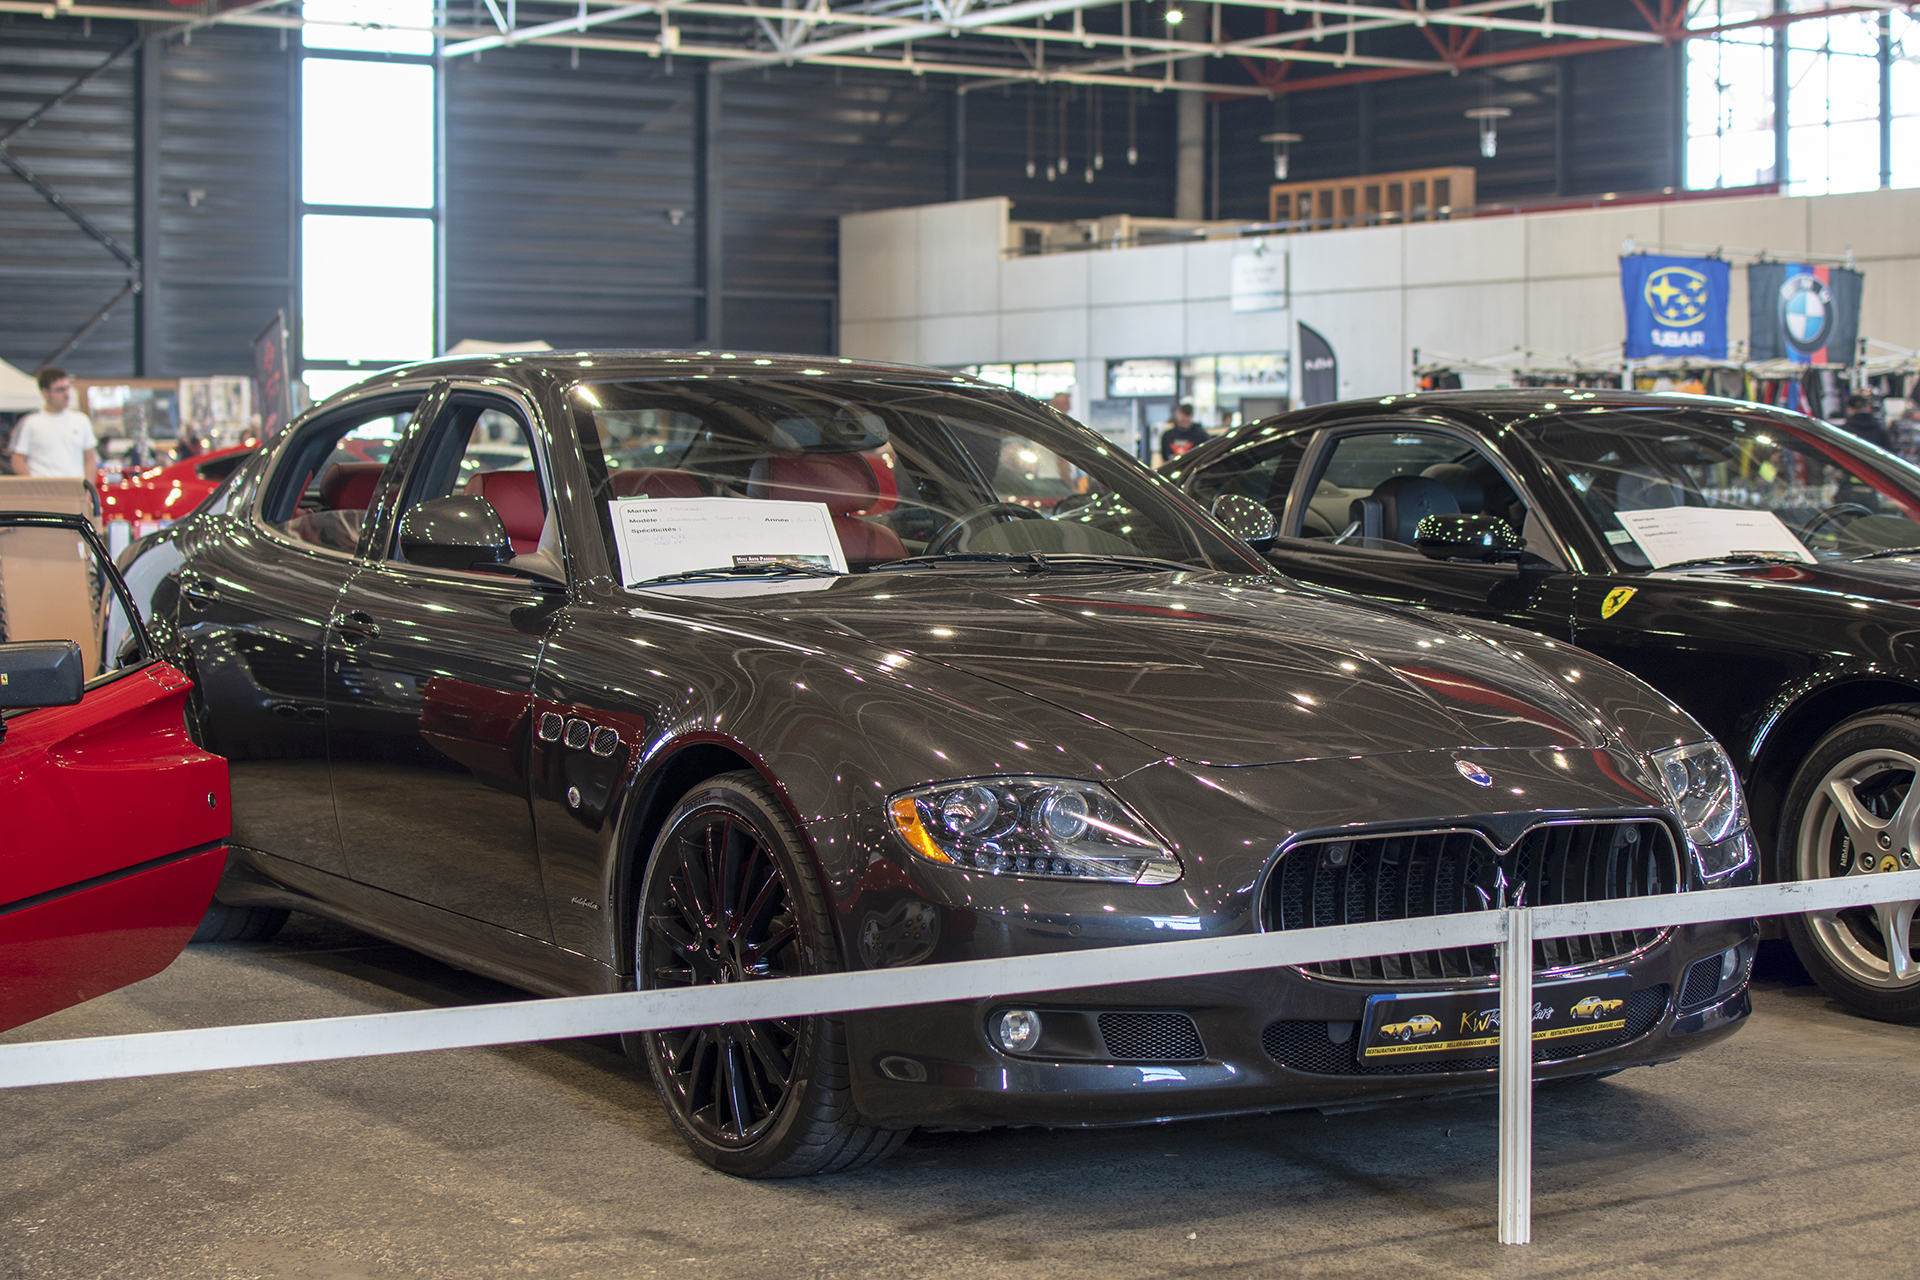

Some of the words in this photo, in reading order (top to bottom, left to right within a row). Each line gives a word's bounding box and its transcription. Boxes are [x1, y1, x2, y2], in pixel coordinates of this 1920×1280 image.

[1781, 277, 1830, 304] BMW
[1366, 1046, 1397, 1054] RESTAURATION
[1550, 1028, 1576, 1036] RESTAURATION
[1576, 1025, 1595, 1033] PLASTIQUE
